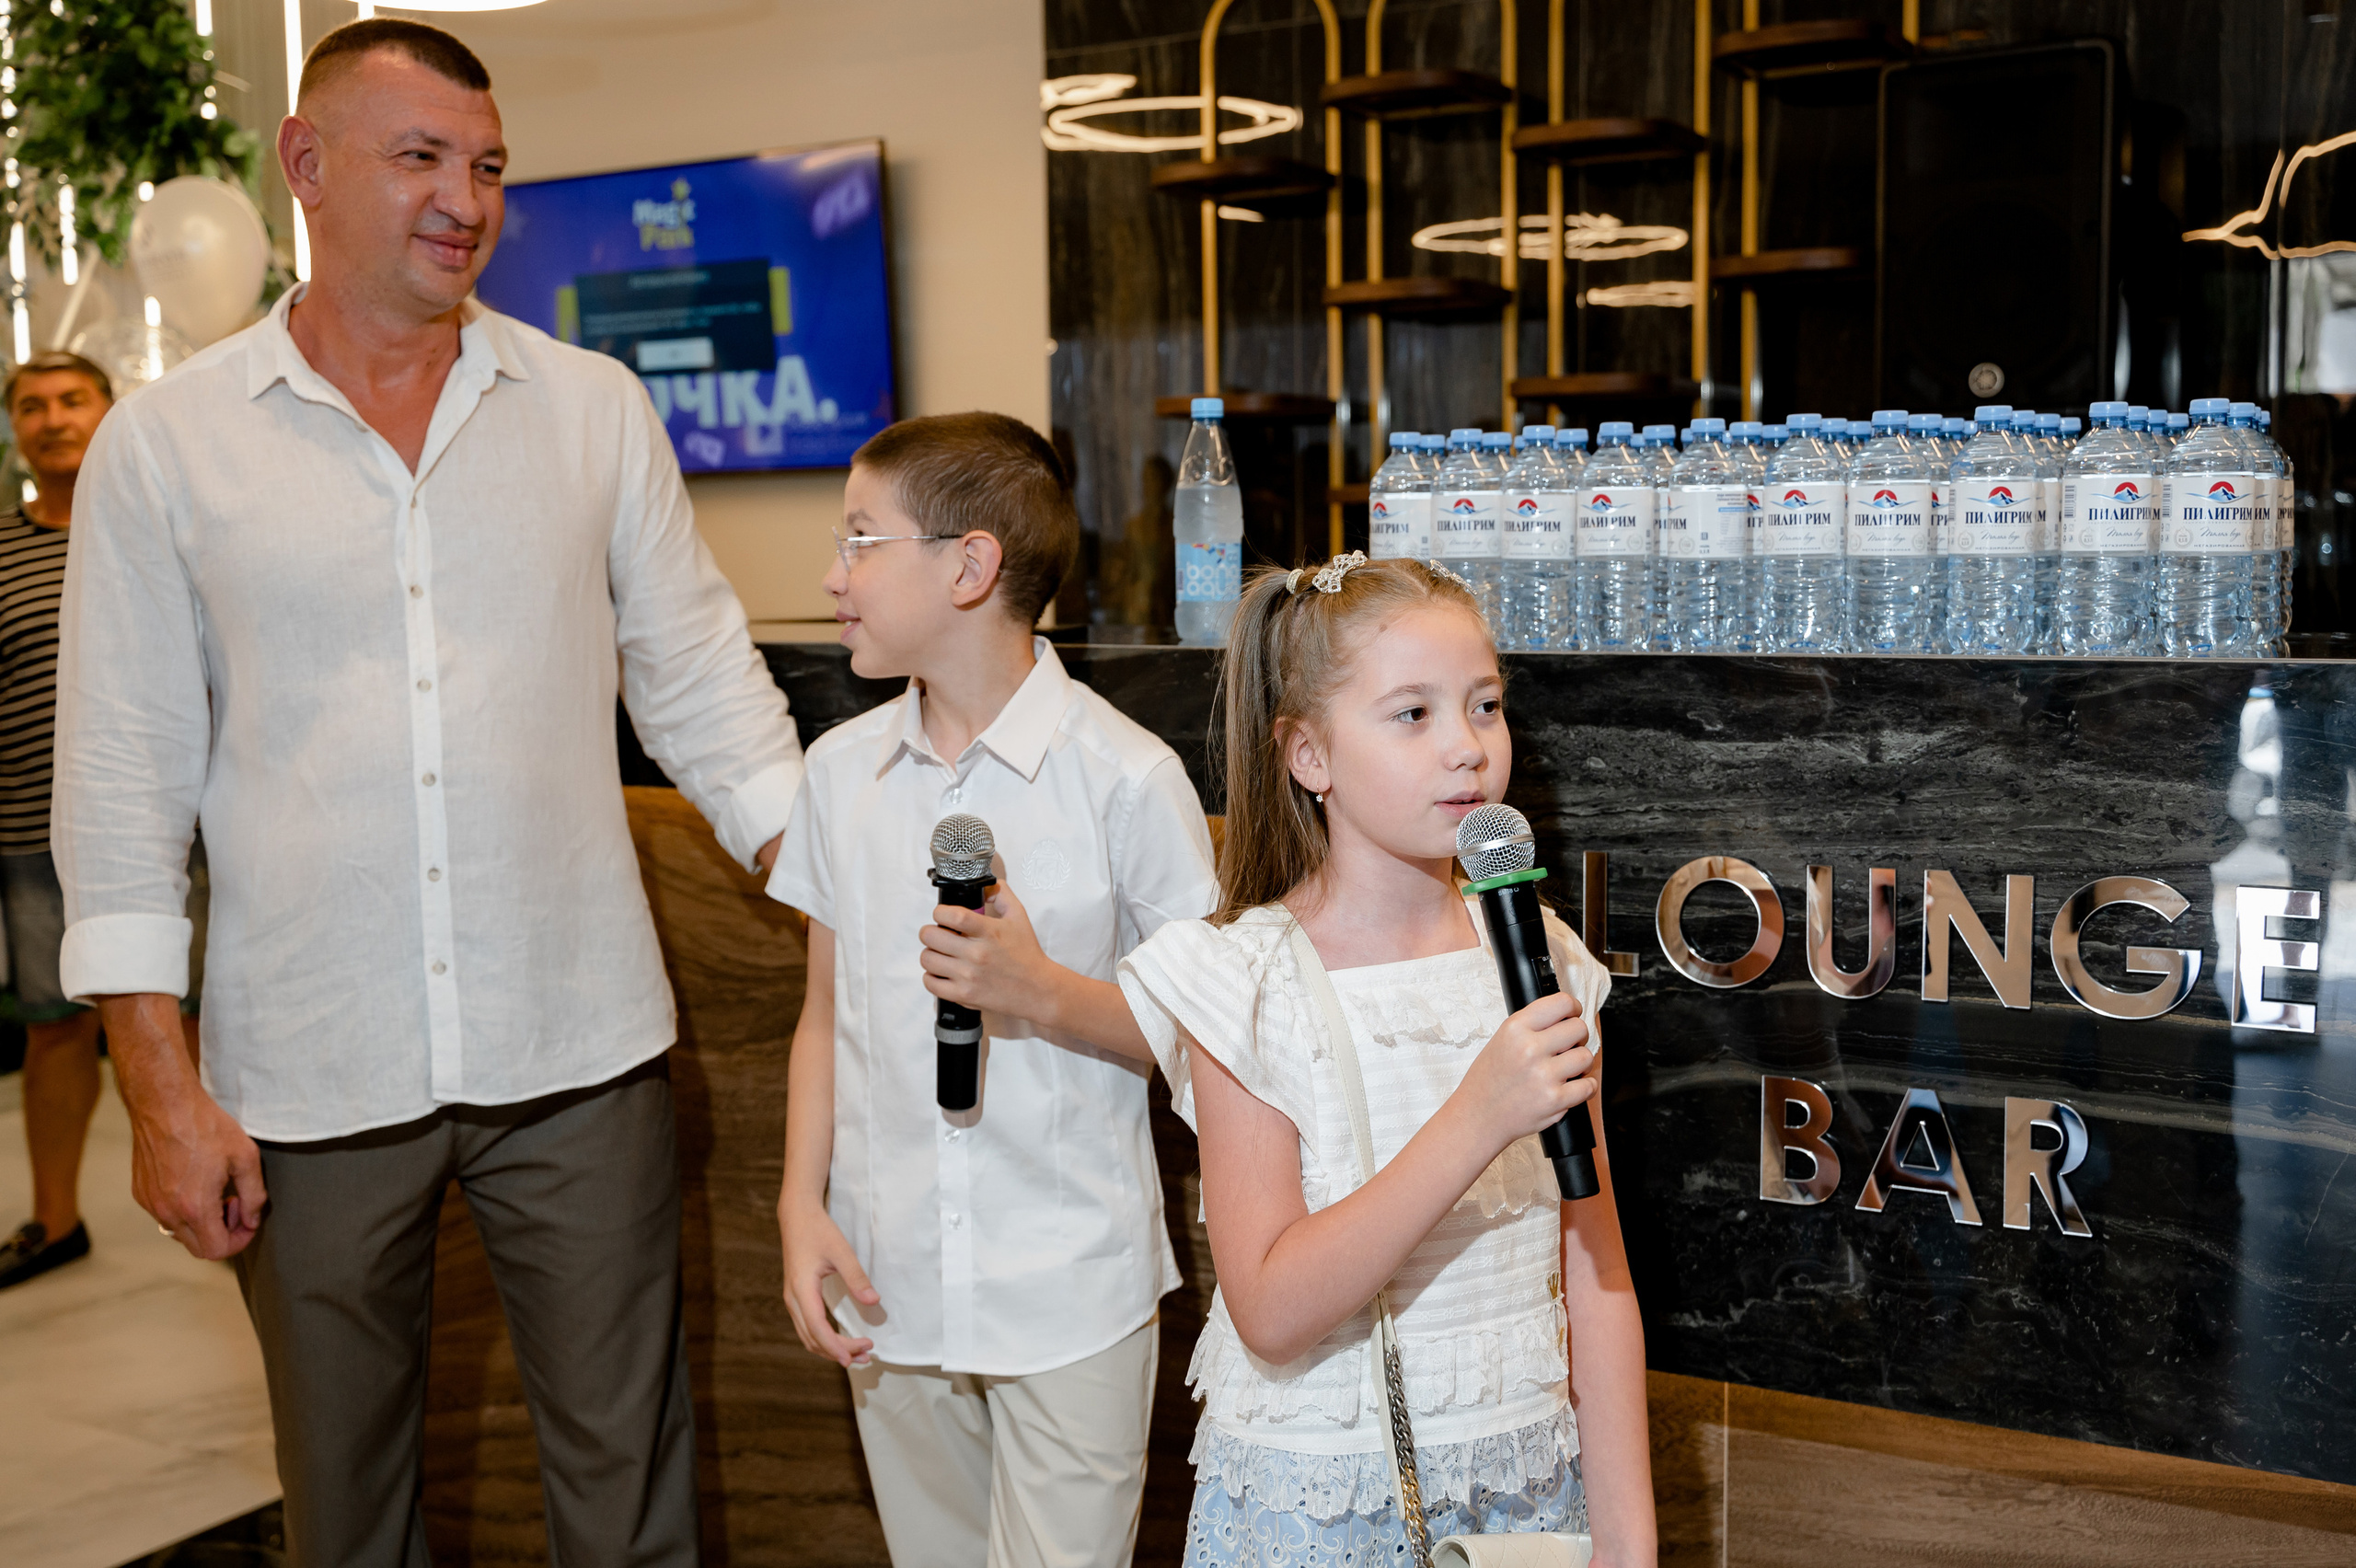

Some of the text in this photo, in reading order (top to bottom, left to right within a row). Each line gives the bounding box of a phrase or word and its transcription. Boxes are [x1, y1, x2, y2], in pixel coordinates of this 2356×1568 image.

[1768, 513, 1831, 526] ПИЛИГРИМ
[1854, 513, 1921, 526] ПИЛИГРИМ
[1965, 511, 2032, 525] ПИЛИГРИМ
[2088, 507, 2152, 521] ПИЛИГРИМ
[2183, 507, 2252, 521] ПИЛИГРИМ
[1438, 519, 1496, 532] ПИЛИГРИМ
[1504, 521, 1561, 533] ПИЛИГРИМ
[1579, 515, 1636, 528] ПИЛИГРИМ
[1583, 849, 2321, 1034] LOUNGE
[1760, 1074, 2093, 1239] BAR
